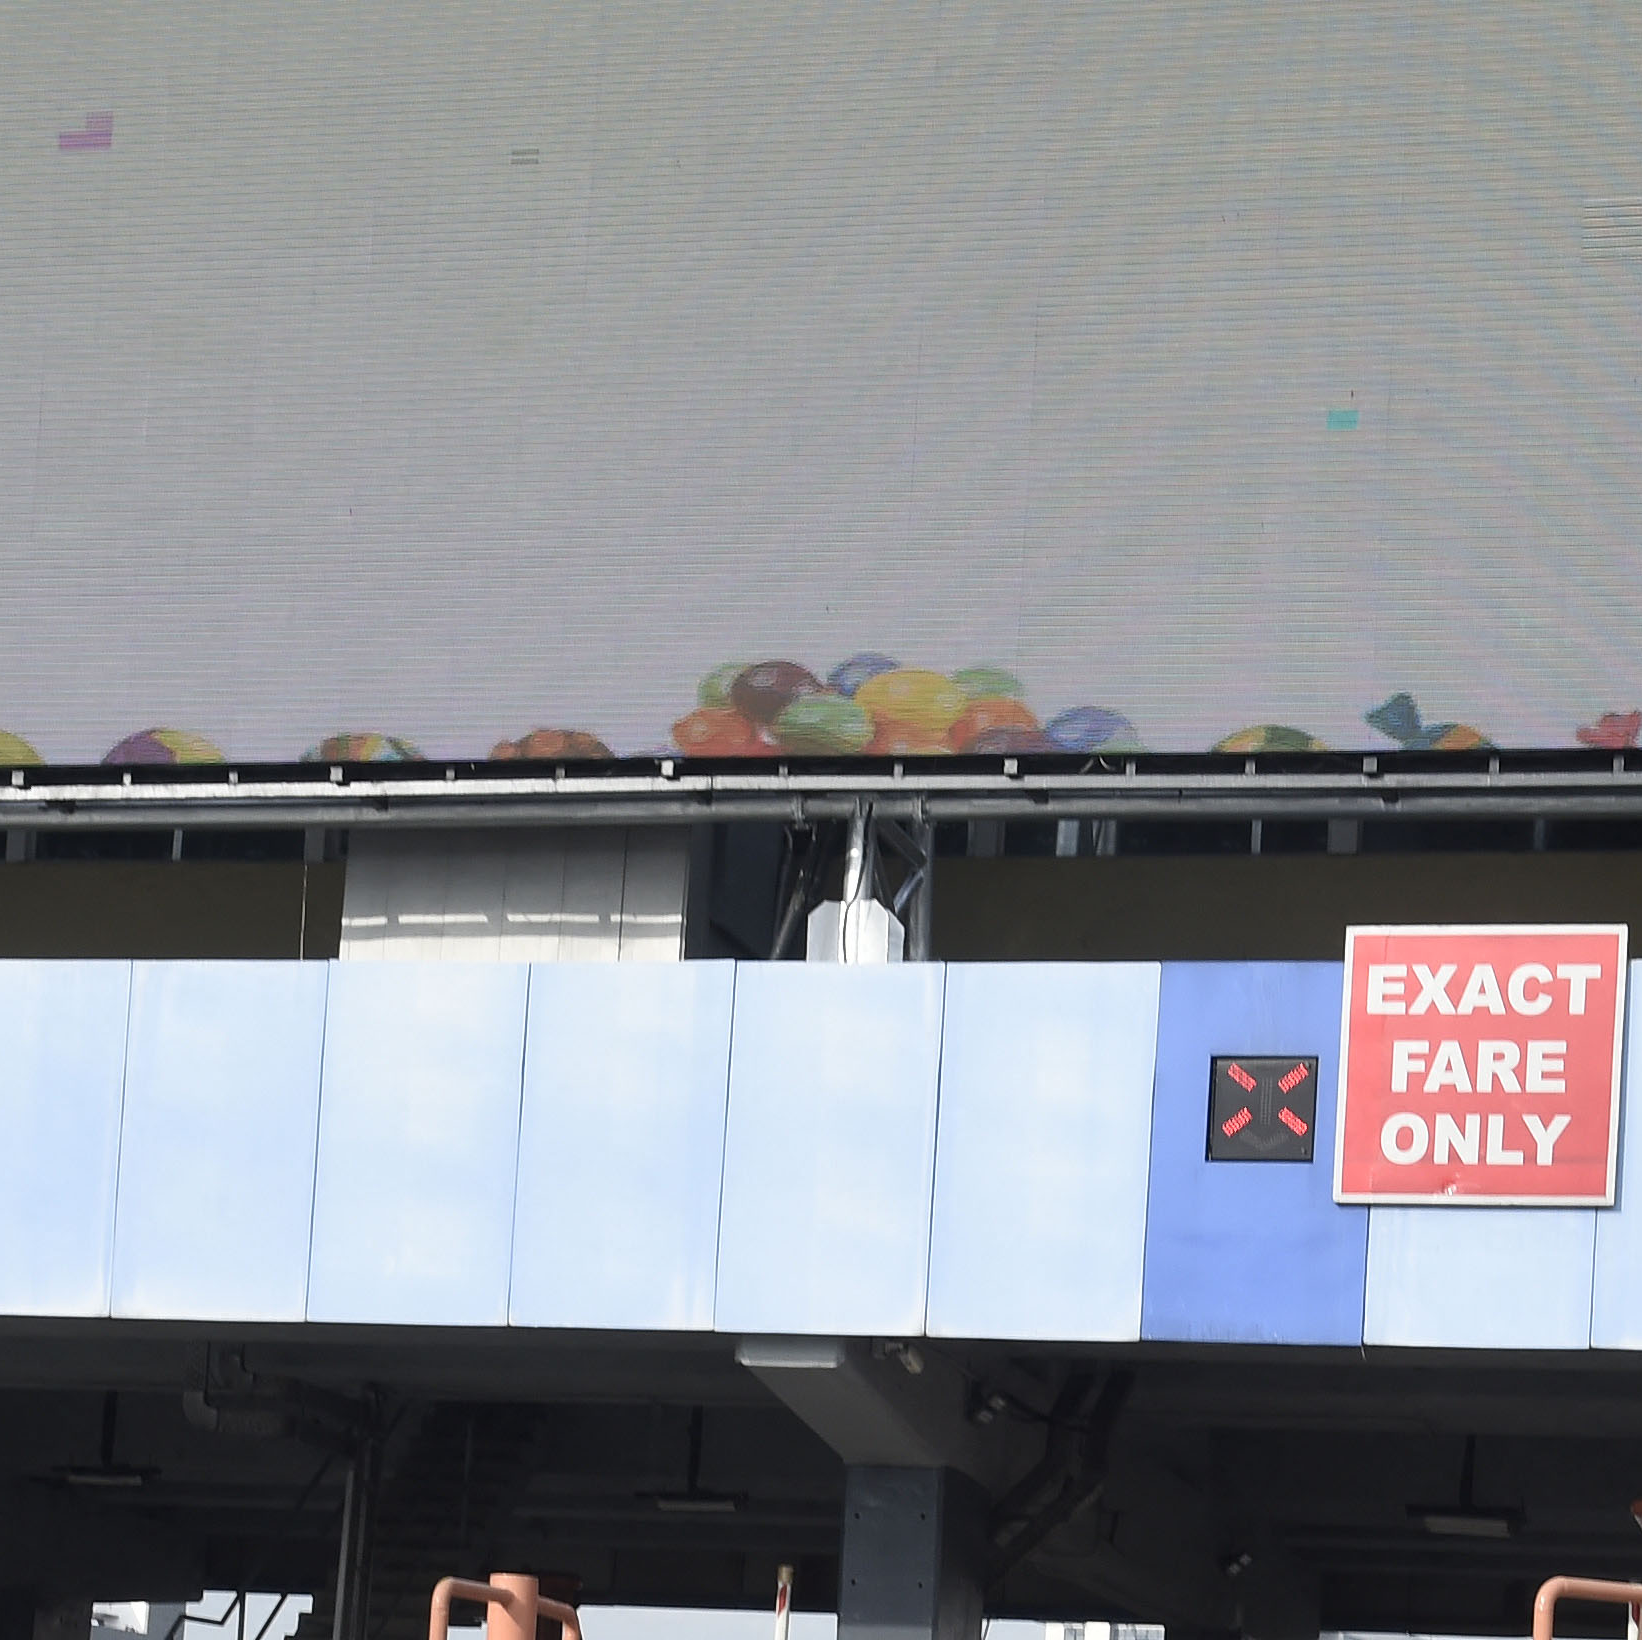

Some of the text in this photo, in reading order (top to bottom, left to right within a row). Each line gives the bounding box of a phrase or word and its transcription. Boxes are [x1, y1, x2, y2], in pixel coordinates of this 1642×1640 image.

[1366, 961, 1603, 1017] EXACT
[1391, 1039, 1567, 1094] FARE
[1379, 1112, 1572, 1167] ONLY
